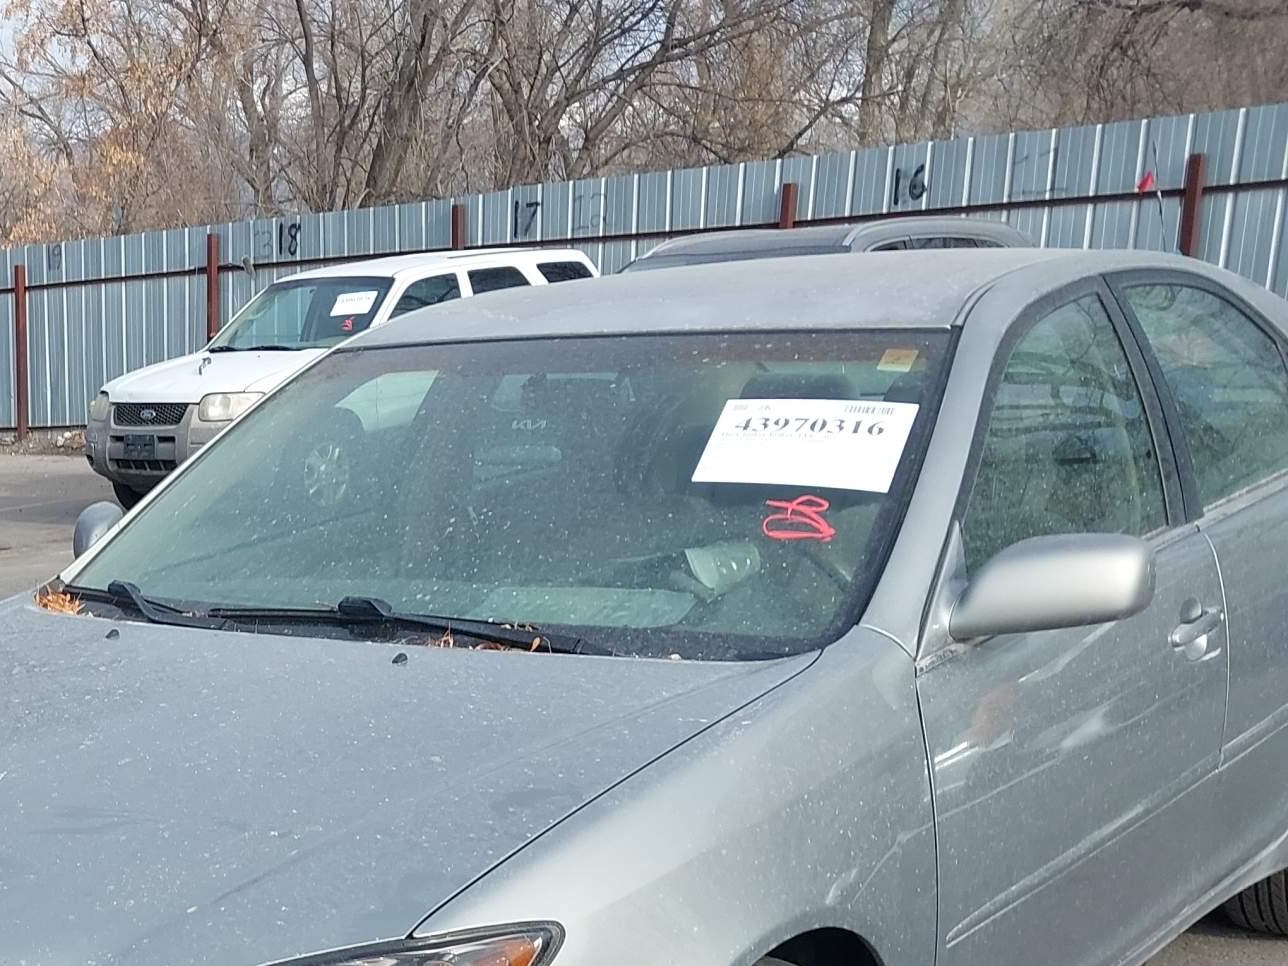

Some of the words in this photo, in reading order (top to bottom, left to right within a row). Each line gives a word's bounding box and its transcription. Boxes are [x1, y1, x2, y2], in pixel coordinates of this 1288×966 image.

[894, 164, 928, 206] 16
[514, 200, 541, 238] 17
[279, 222, 301, 256] 18
[47, 244, 62, 272] 19
[735, 416, 885, 436] 43970316
